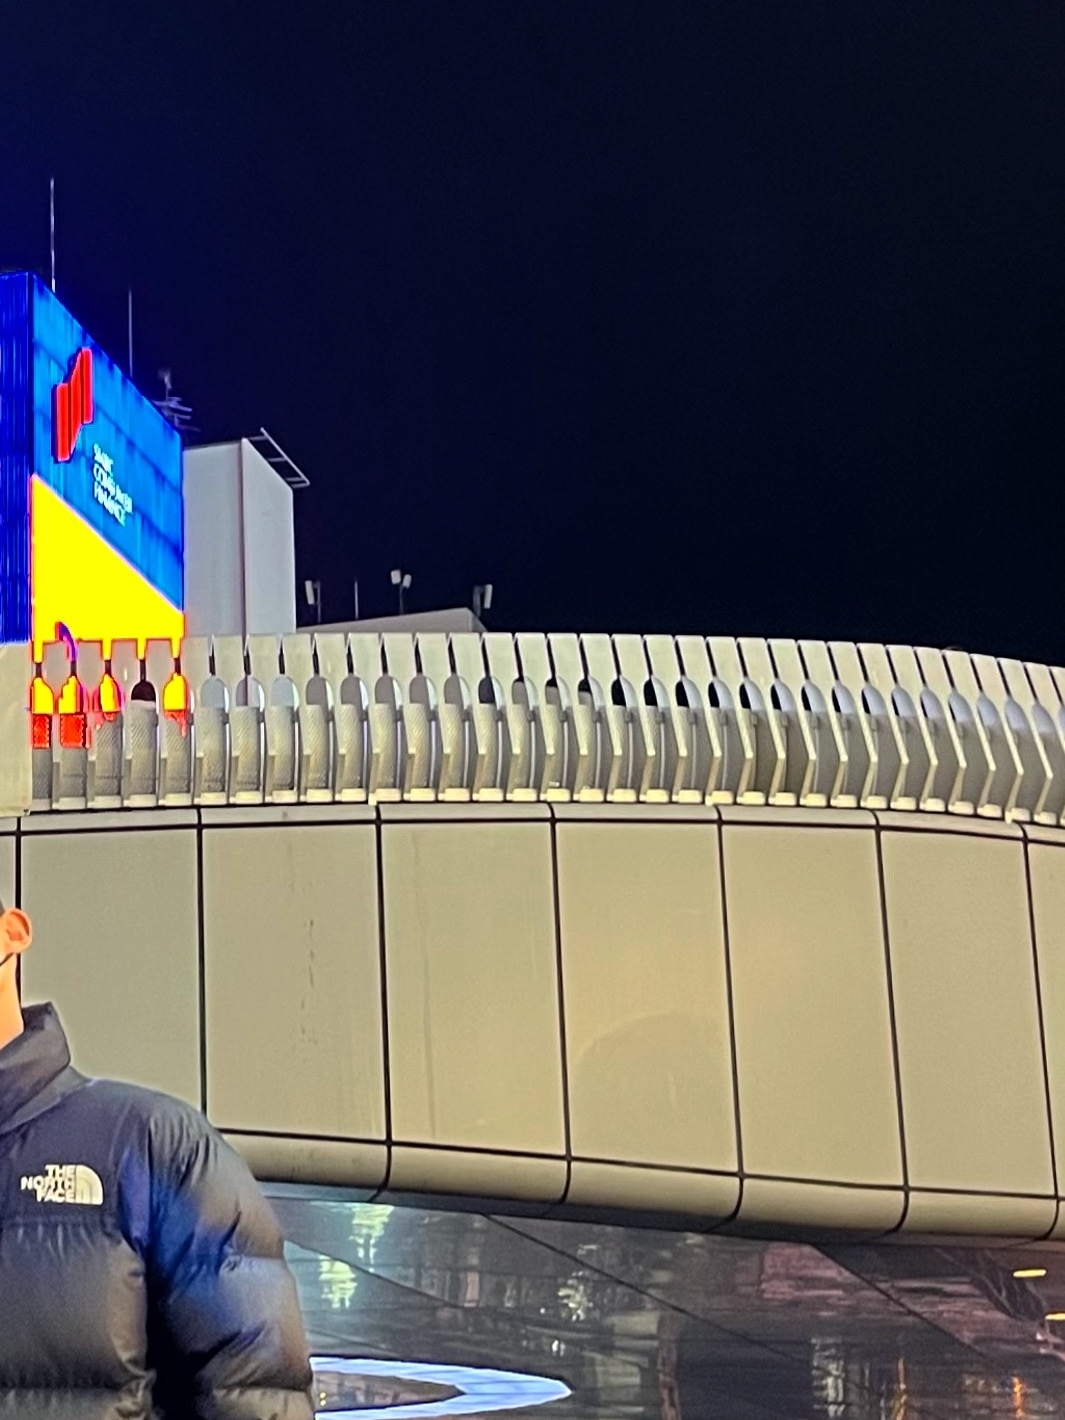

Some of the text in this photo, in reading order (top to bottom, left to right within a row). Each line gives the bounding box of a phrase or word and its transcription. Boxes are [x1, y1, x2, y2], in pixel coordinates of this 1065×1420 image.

[44, 1164, 76, 1178] THE
[20, 1175, 76, 1191] NORTH
[36, 1188, 76, 1203] FACE
